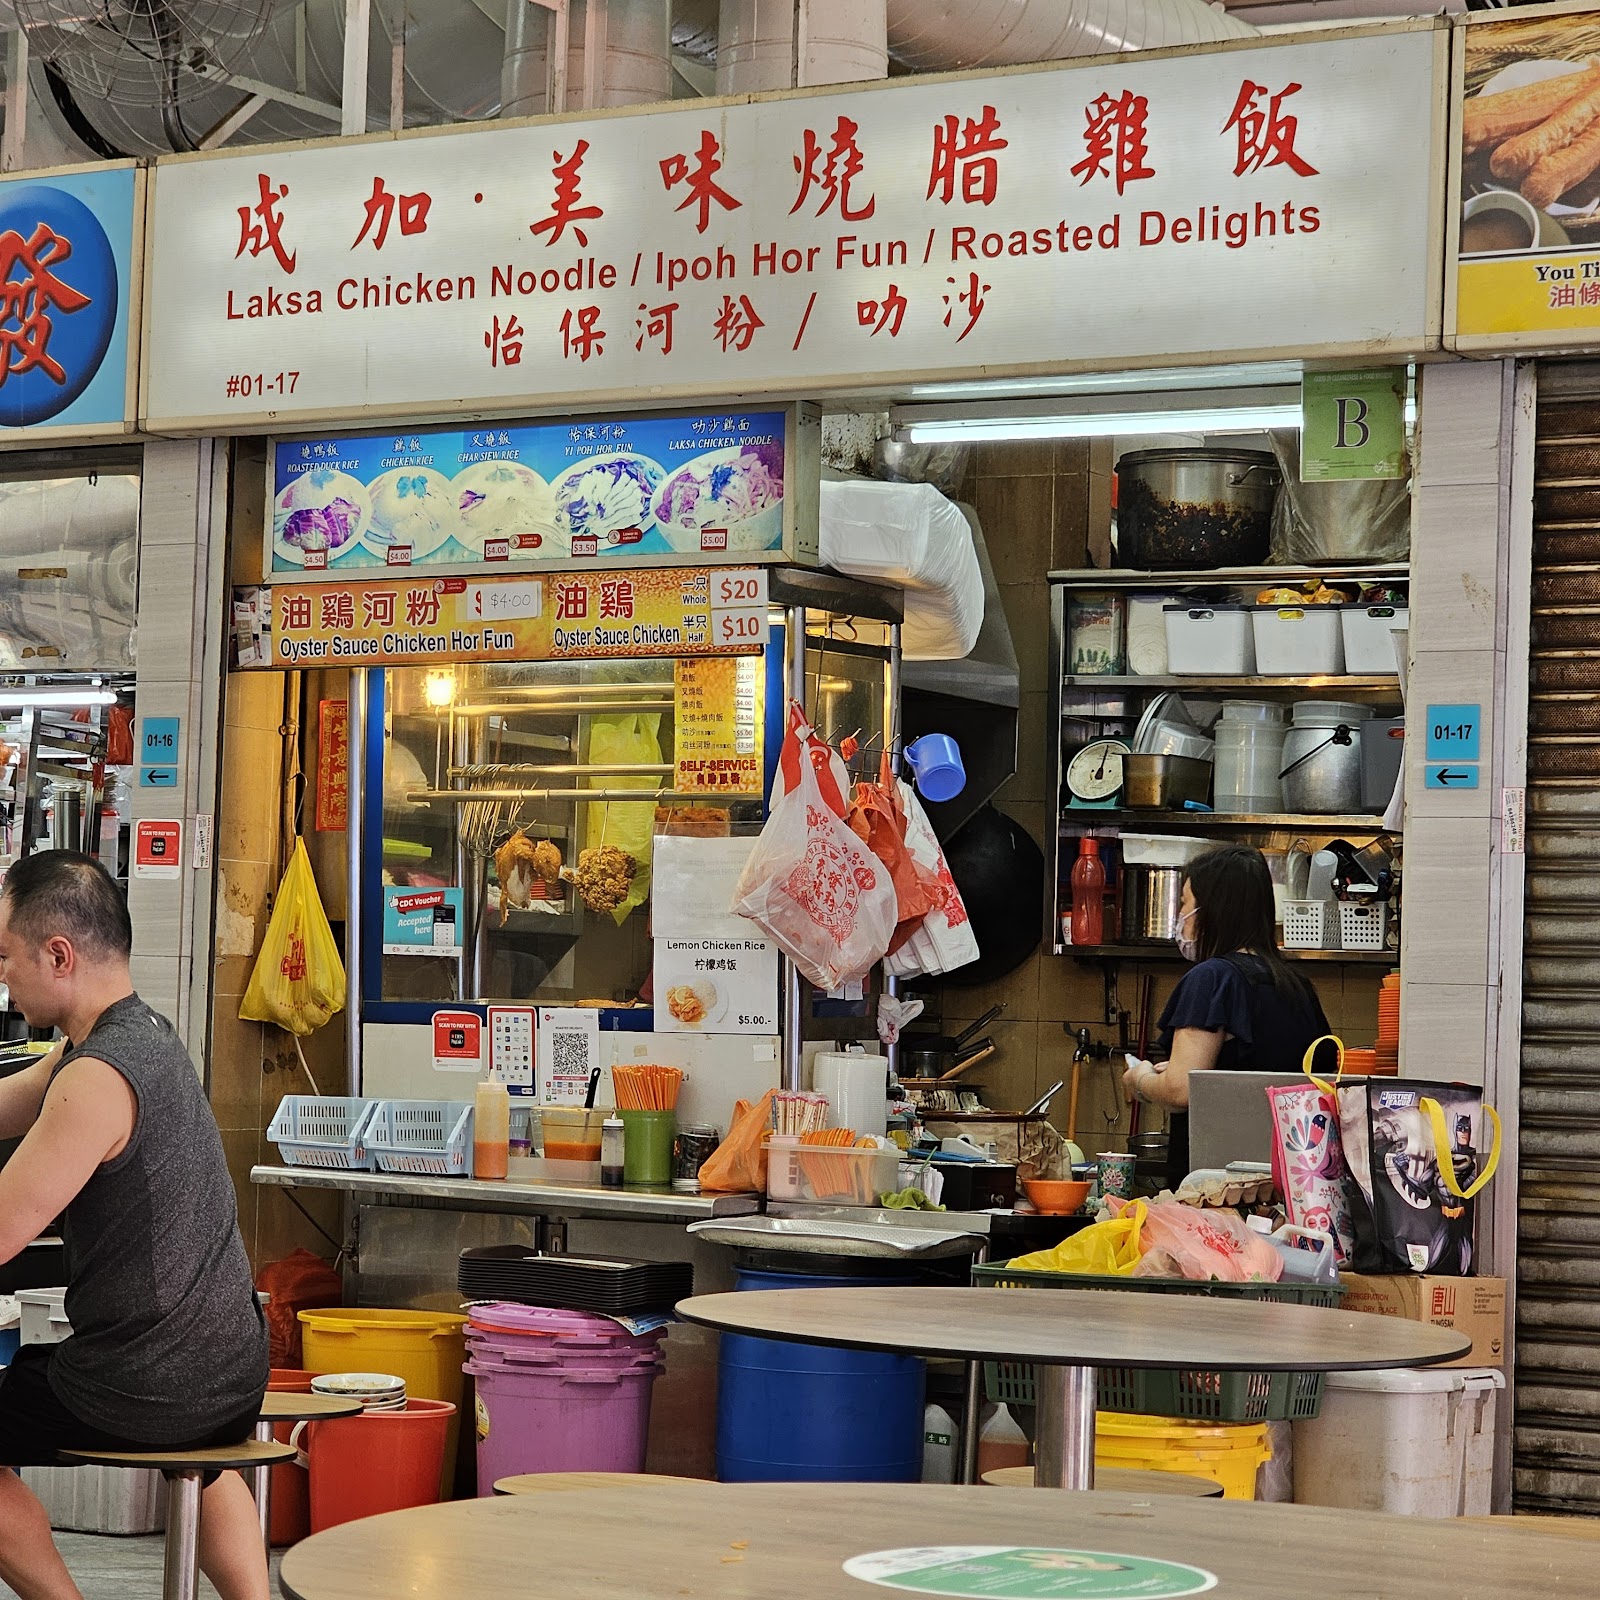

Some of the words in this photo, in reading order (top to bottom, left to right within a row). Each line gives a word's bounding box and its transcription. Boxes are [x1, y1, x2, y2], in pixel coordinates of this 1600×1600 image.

[227, 288, 322, 320] Laksa
[337, 274, 477, 310] Chicken
[491, 258, 618, 297] Noodle
[631, 255, 642, 285] /
[656, 246, 736, 291] Ipoh
[753, 240, 821, 275] Hor
[836, 235, 908, 270] Fun
[924, 230, 936, 260] /
[952, 210, 1121, 260] Roasted
[1140, 202, 1321, 248] Delights
[1535, 266, 1575, 281] You
[226, 371, 300, 398] #01-17
[1332, 397, 1370, 449] B
[669, 438, 696, 450] LAKSA
[698, 436, 736, 449] CHICKEN
[738, 434, 773, 447] NOODLE
[564, 446, 574, 456] YI
[576, 445, 593, 455] POH
[595, 444, 614, 454] HOR
[615, 442, 633, 453] FUN
[380, 456, 414, 469] CHICKEN
[415, 455, 434, 466] RICE
[457, 451, 480, 463] CHAR
[480, 450, 499, 462] SIEW
[499, 449, 519, 461] RICE
[287, 460, 320, 474] ROASTED
[320, 460, 341, 472] DUCK
[342, 459, 360, 470] RICE
[703, 534, 725, 545] $5.00
[486, 545, 507, 556] $4.00
[573, 543, 595, 552] $3.50
[304, 554, 324, 565] $4.50
[390, 551, 409, 562] $4.00
[682, 577, 707, 591] 一只
[720, 578, 759, 602] $20
[682, 594, 707, 604] Whole
[683, 615, 707, 629] 半只
[722, 615, 760, 641] $10
[554, 626, 592, 651] Oyster
[594, 625, 629, 646] Sauce
[632, 623, 680, 645] Chicken
[688, 632, 704, 642] Half
[280, 636, 328, 661] Oyster
[332, 635, 378, 656] Sauce
[383, 633, 447, 654] Chicken
[452, 631, 479, 650] Hor
[484, 630, 514, 649] Fun
[737, 661, 754, 669] $4.50
[736, 729, 753, 737] $5.00
[1434, 724, 1472, 740] 01-17
[147, 734, 173, 747] 01-16
[680, 759, 757, 772] SELF-SERVICE
[399, 899, 413, 907] CDC
[415, 896, 441, 905] Voucher
[398, 915, 432, 927] Accepted
[414, 926, 432, 935] here
[667, 940, 700, 950] Lemon
[702, 940, 742, 950] Chicken
[744, 941, 766, 950] Rice
[695, 959, 737, 971] 柠檬鸡饭
[1382, 1091, 1413, 1100] JUSTICE
[1386, 1099, 1411, 1107] LEAGUE
[1431, 1285, 1456, 1316] 唐山
[1363, 1305, 1376, 1313] DRY
[1378, 1306, 1398, 1314] PLACE
